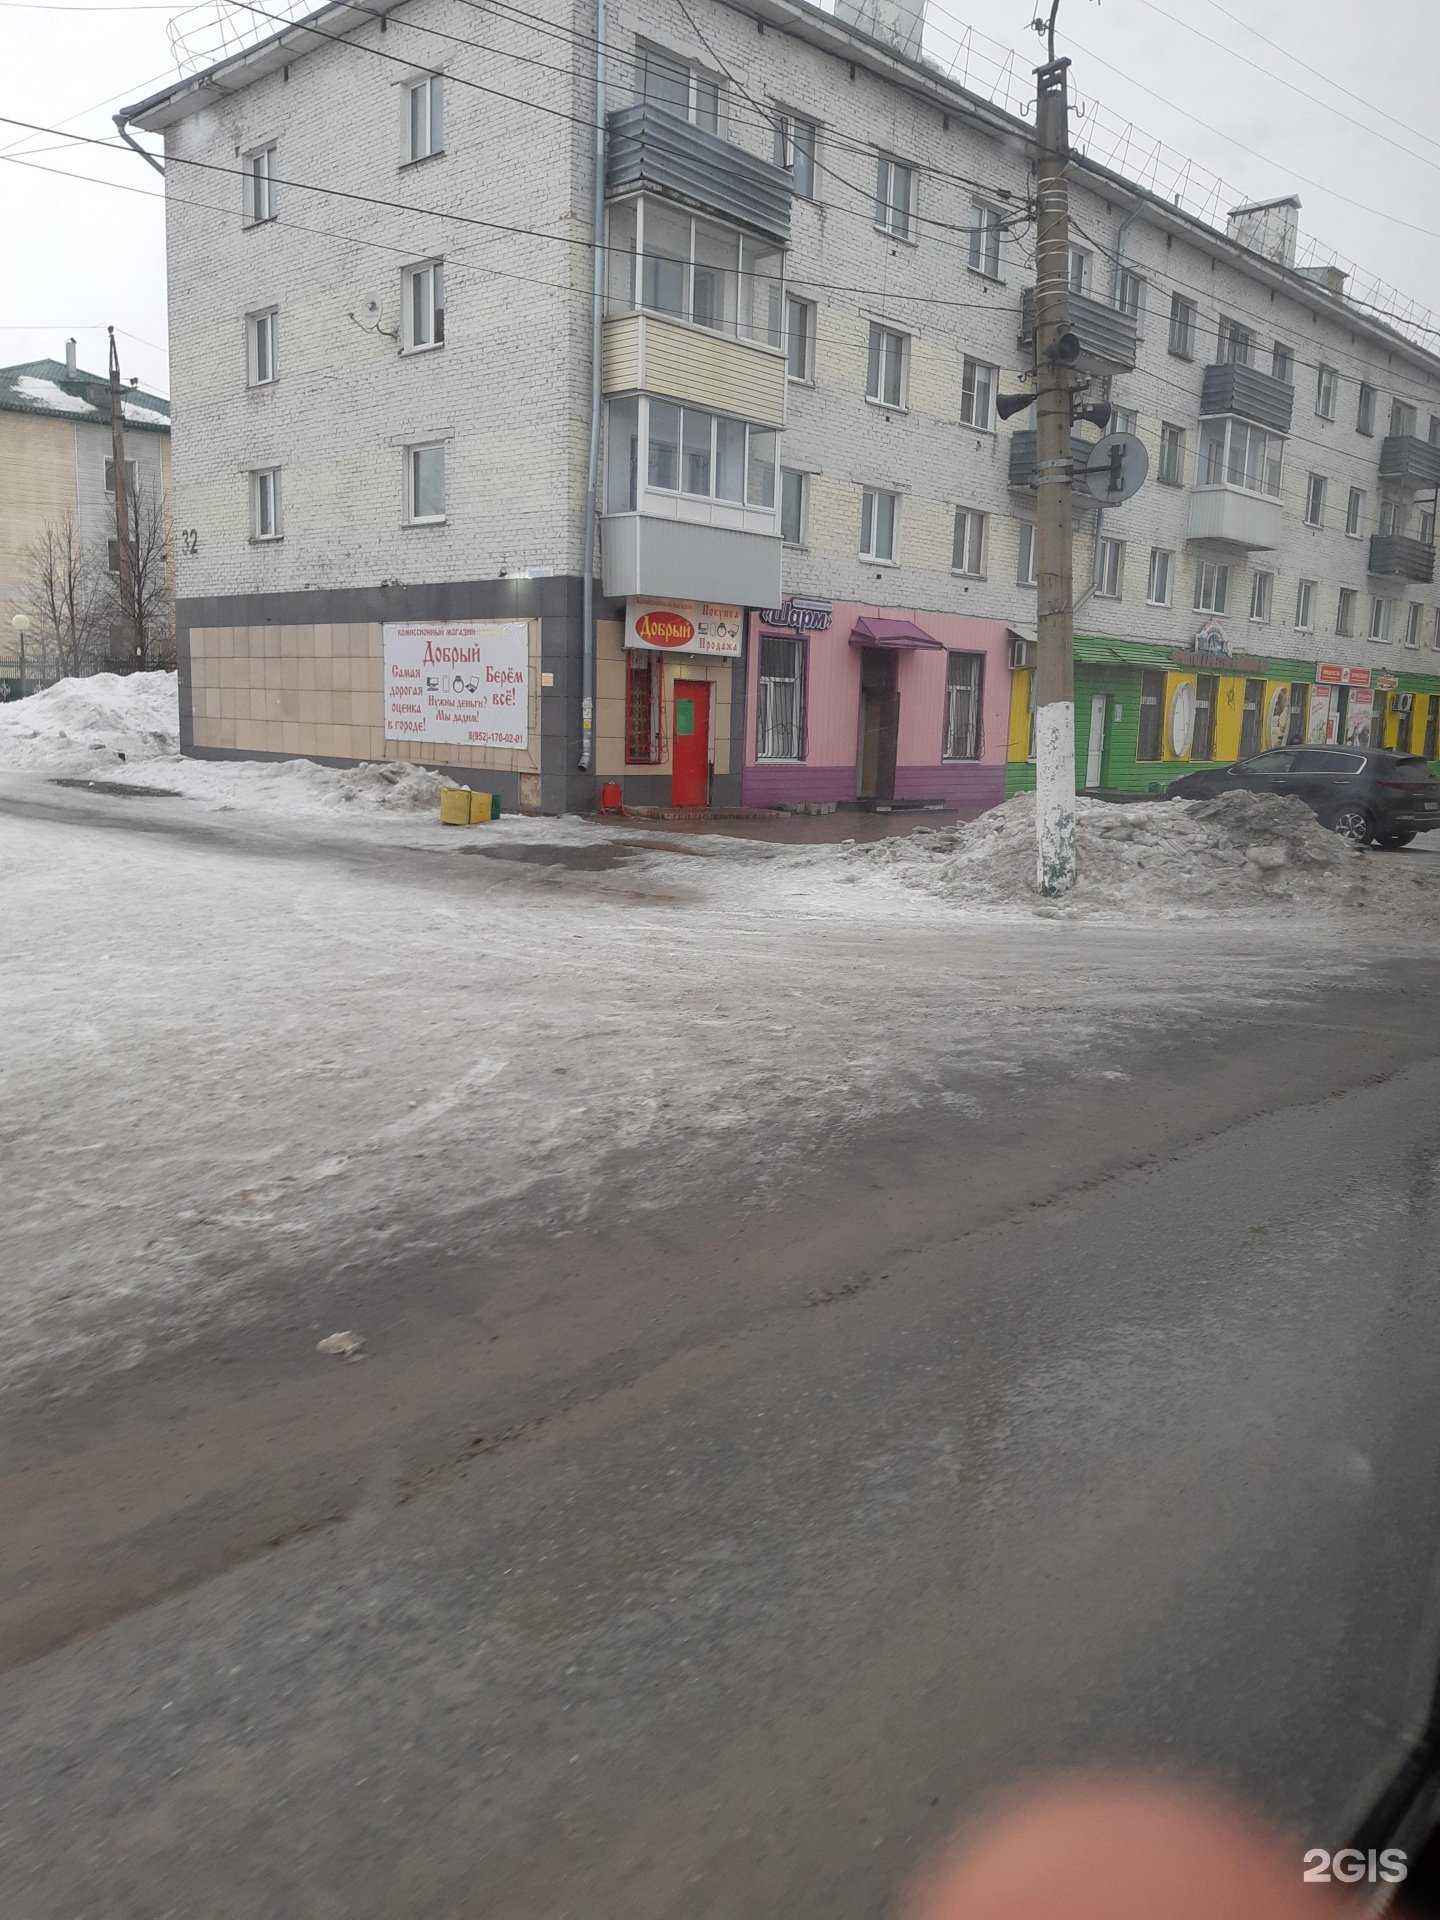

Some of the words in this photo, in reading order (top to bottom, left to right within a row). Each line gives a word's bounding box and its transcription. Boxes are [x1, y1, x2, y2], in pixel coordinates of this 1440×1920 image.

[640, 615, 692, 642] Добрый
[422, 640, 481, 669] Добрый
[699, 637, 738, 653] Продажа
[391, 664, 422, 679] Самая
[485, 665, 524, 687] Берём
[492, 687, 516, 706] всё!
[435, 709, 451, 721] Мы
